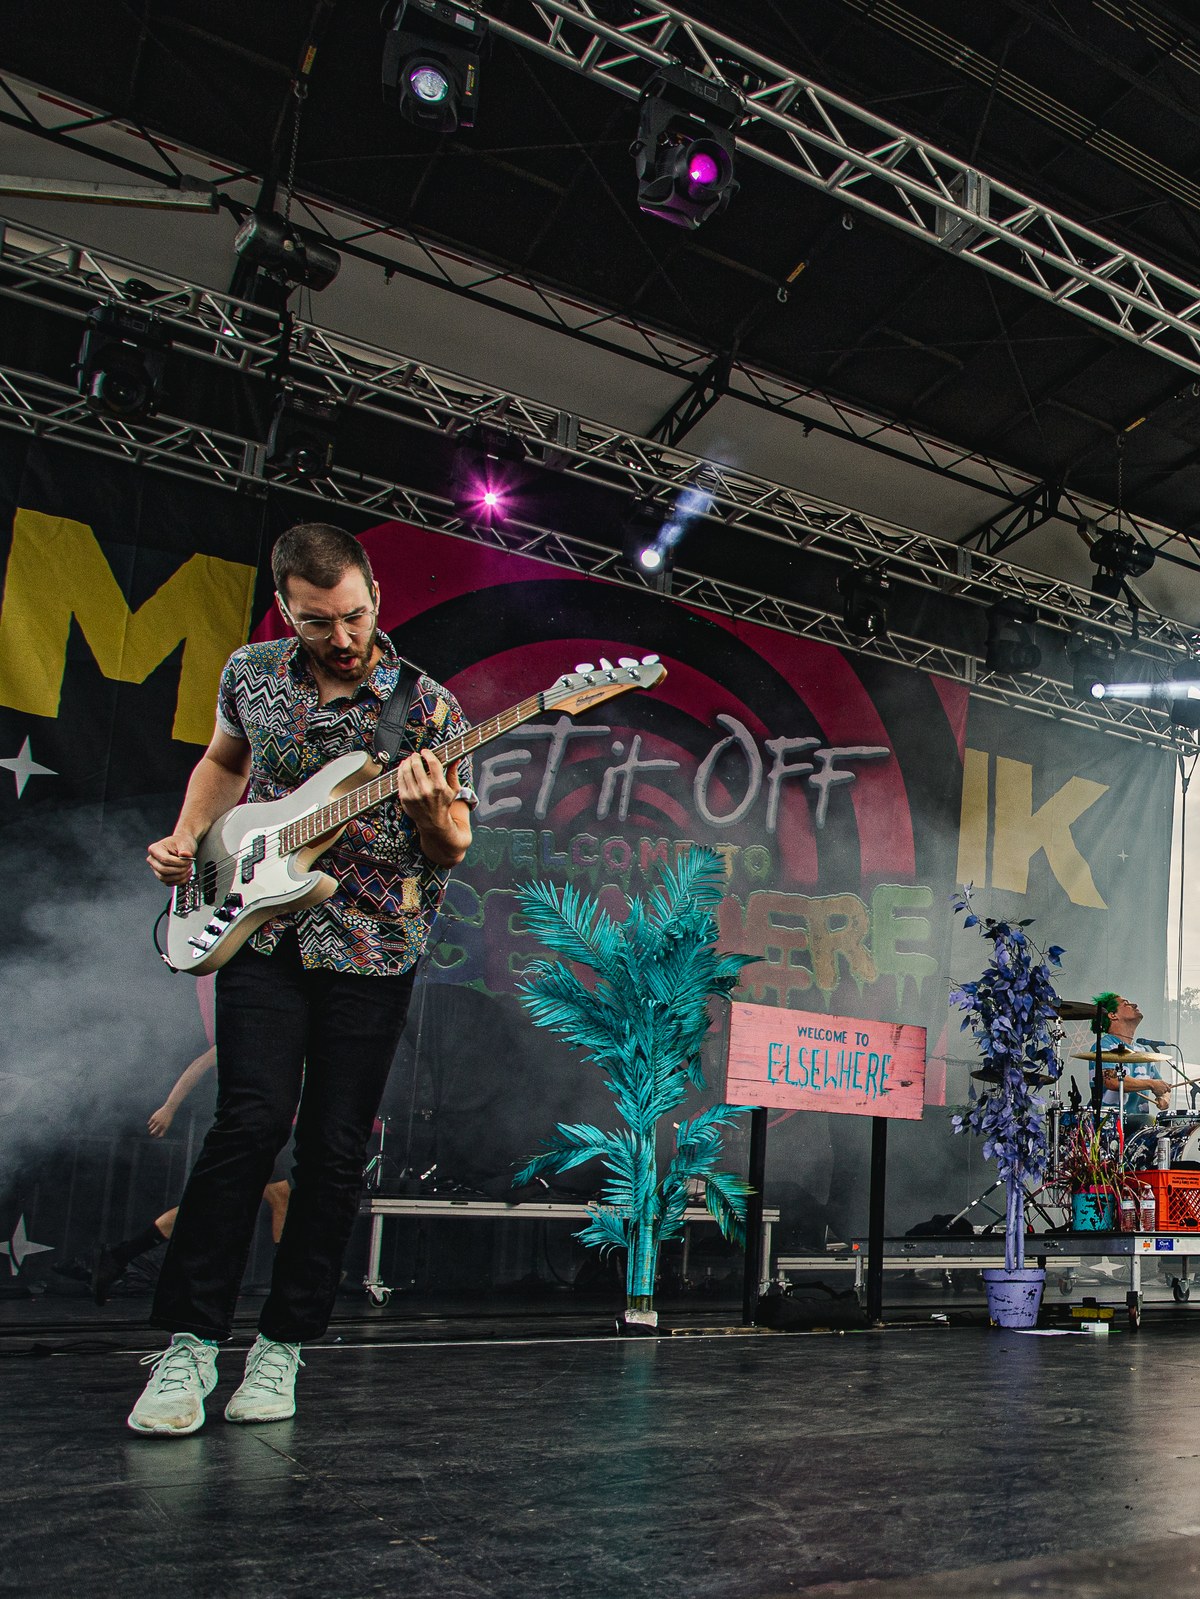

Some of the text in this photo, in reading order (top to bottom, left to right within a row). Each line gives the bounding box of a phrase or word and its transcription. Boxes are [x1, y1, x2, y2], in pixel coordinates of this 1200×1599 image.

[477, 715, 611, 820] ET
[694, 713, 891, 834] OFF
[797, 1026, 869, 1046] WELCOME TO
[767, 1042, 892, 1099] ELSEWHERE
